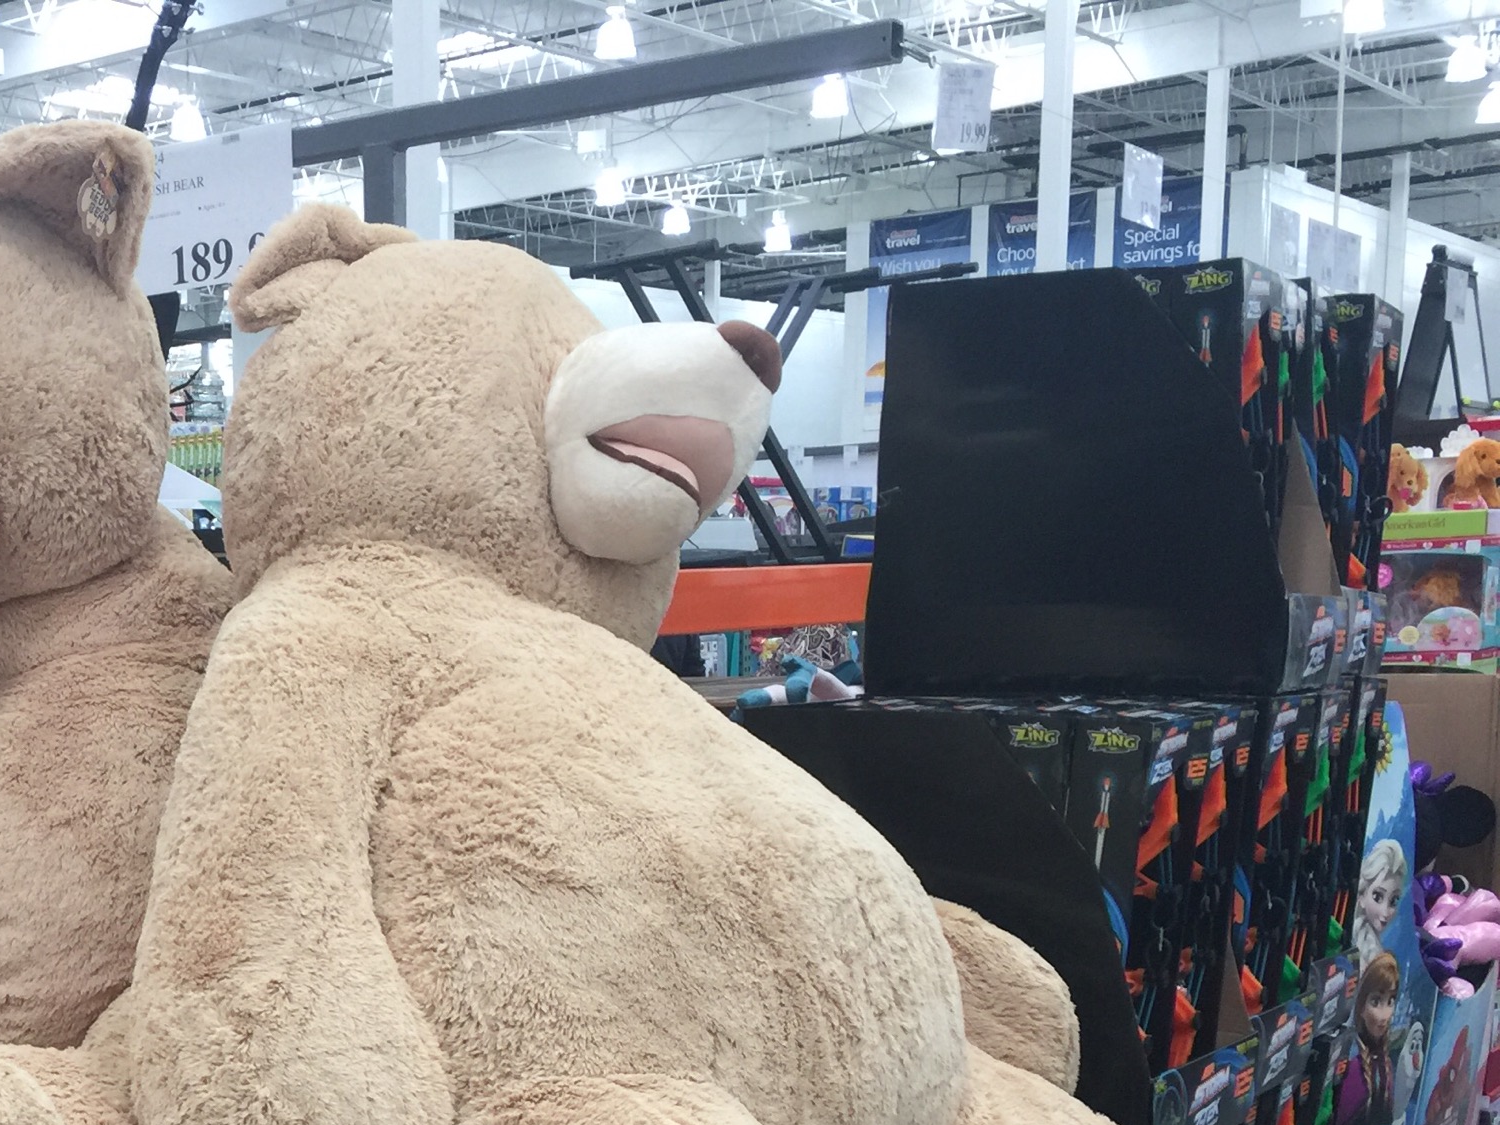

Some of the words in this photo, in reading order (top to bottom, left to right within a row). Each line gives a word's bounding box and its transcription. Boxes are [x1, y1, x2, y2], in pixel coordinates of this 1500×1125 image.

[960, 122, 986, 143] 19.99
[174, 176, 204, 192] BEAR
[1006, 220, 1037, 234] trave
[1124, 223, 1180, 247] Special
[885, 234, 920, 249] travel
[997, 247, 1036, 263] Choo
[1123, 245, 1183, 263] savings
[1187, 240, 1201, 256] fo
[877, 260, 912, 275] Wish
[1013, 727, 1056, 744] ZING
[1091, 731, 1137, 749] ZING
